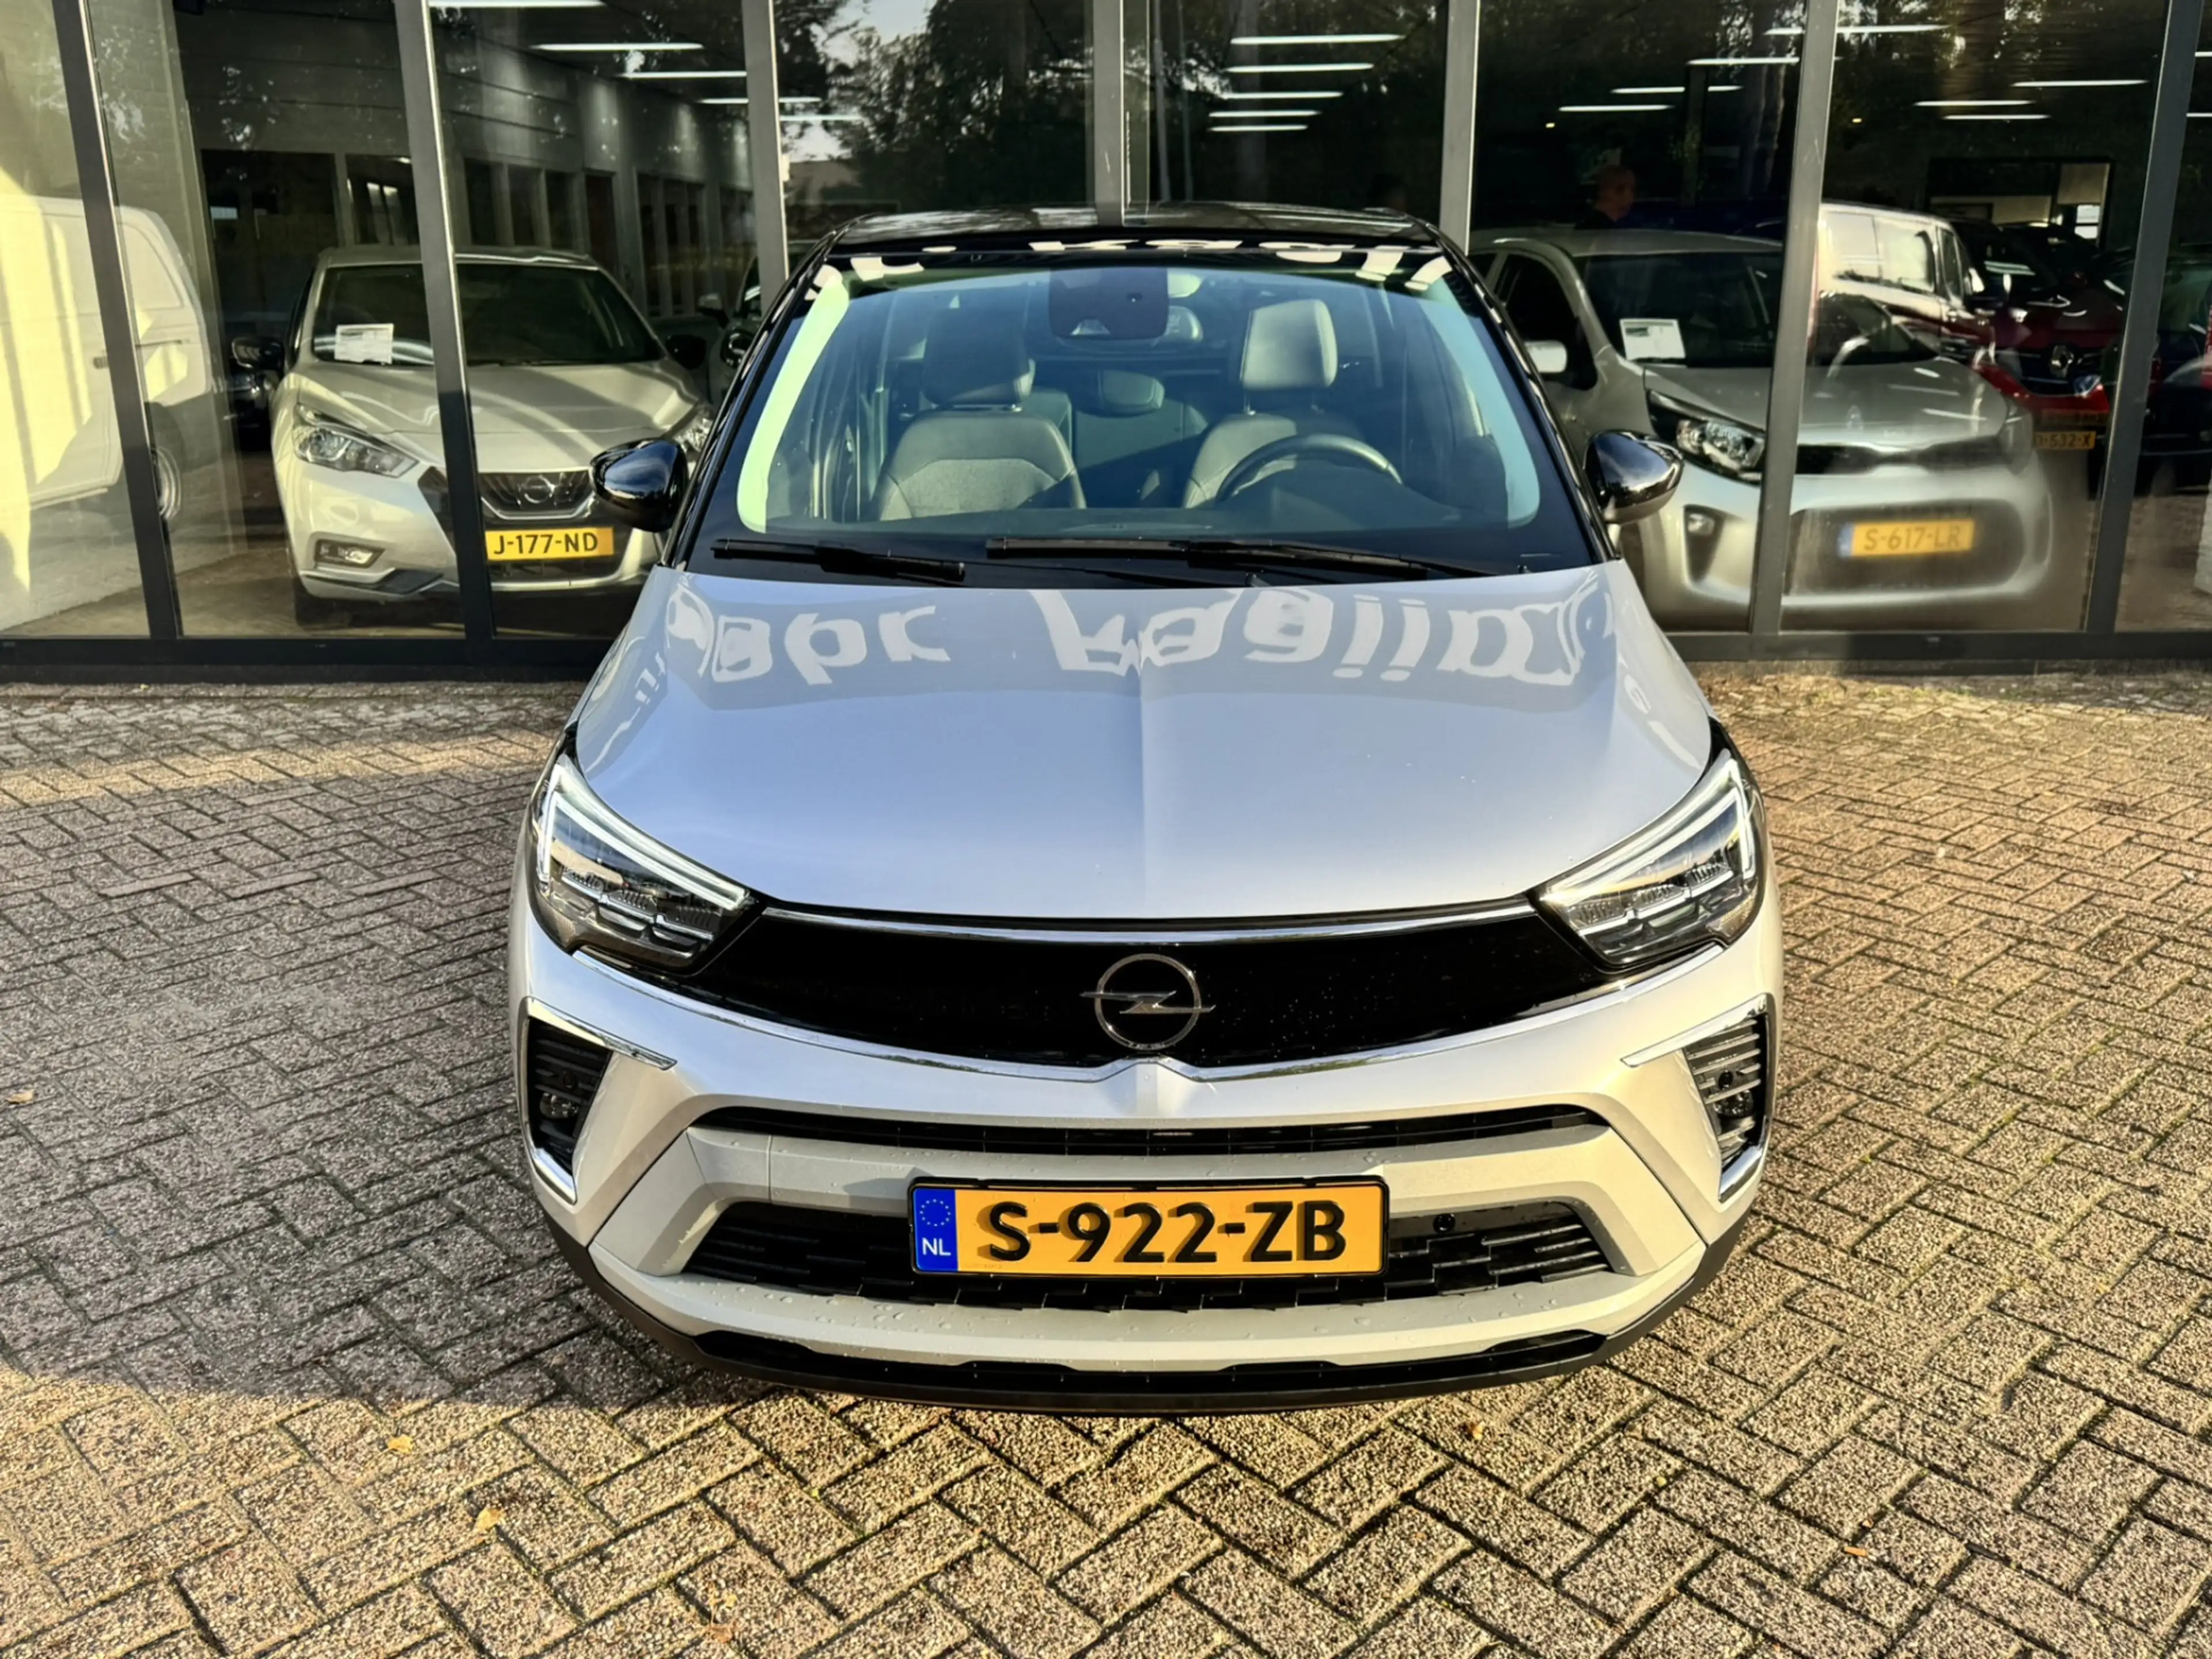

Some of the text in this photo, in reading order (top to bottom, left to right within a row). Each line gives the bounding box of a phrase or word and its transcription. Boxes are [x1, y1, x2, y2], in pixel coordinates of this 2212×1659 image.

[493, 532, 599, 555] J-177-ND
[1863, 525, 1961, 551] S-617-LR
[988, 1200, 1347, 1263] S-922-ZB
[922, 1237, 952, 1256] NL
